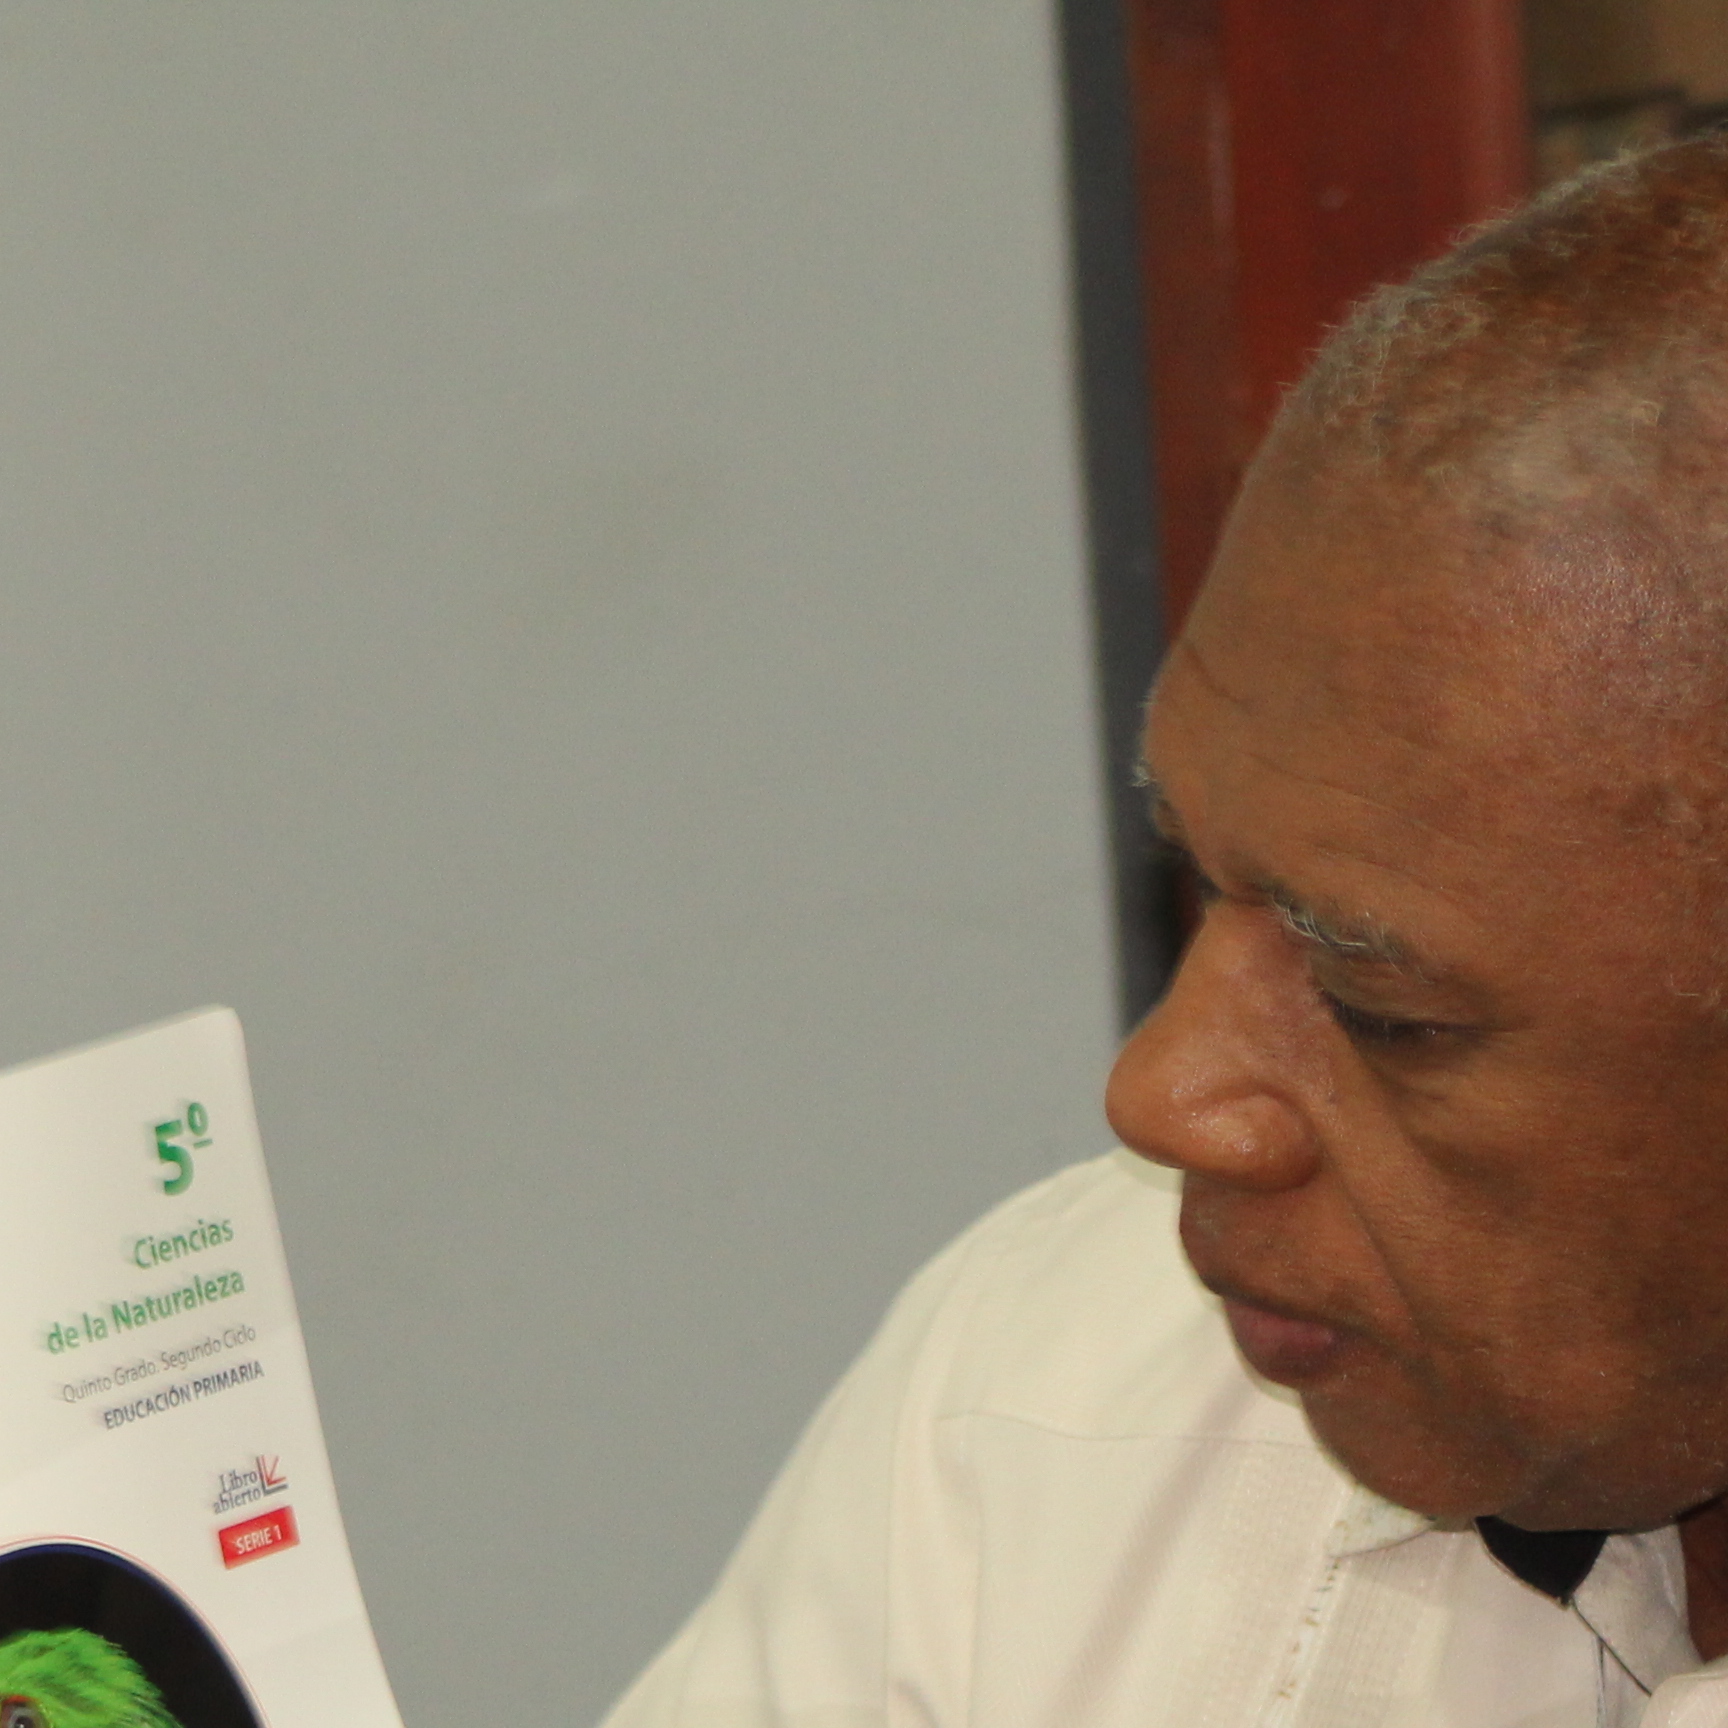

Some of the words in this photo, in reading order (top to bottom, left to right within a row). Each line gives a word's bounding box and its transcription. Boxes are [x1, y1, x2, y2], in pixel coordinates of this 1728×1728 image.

[133, 1217, 235, 1270] Ciencias
[46, 1321, 80, 1355] de
[82, 1311, 109, 1344] la
[111, 1270, 246, 1334] Naturaleza
[62, 1374, 113, 1404] Quinto
[114, 1360, 160, 1387] Grado.
[161, 1336, 222, 1371] Segundo
[223, 1325, 257, 1351] Ciclo
[103, 1385, 192, 1431] EDUCACIÓN
[193, 1359, 265, 1401] PRIMARIA
[212, 1485, 262, 1515] abierto
[218, 1468, 258, 1494] Libro
[235, 1528, 273, 1556] SERIE
[273, 1524, 283, 1542] 1
